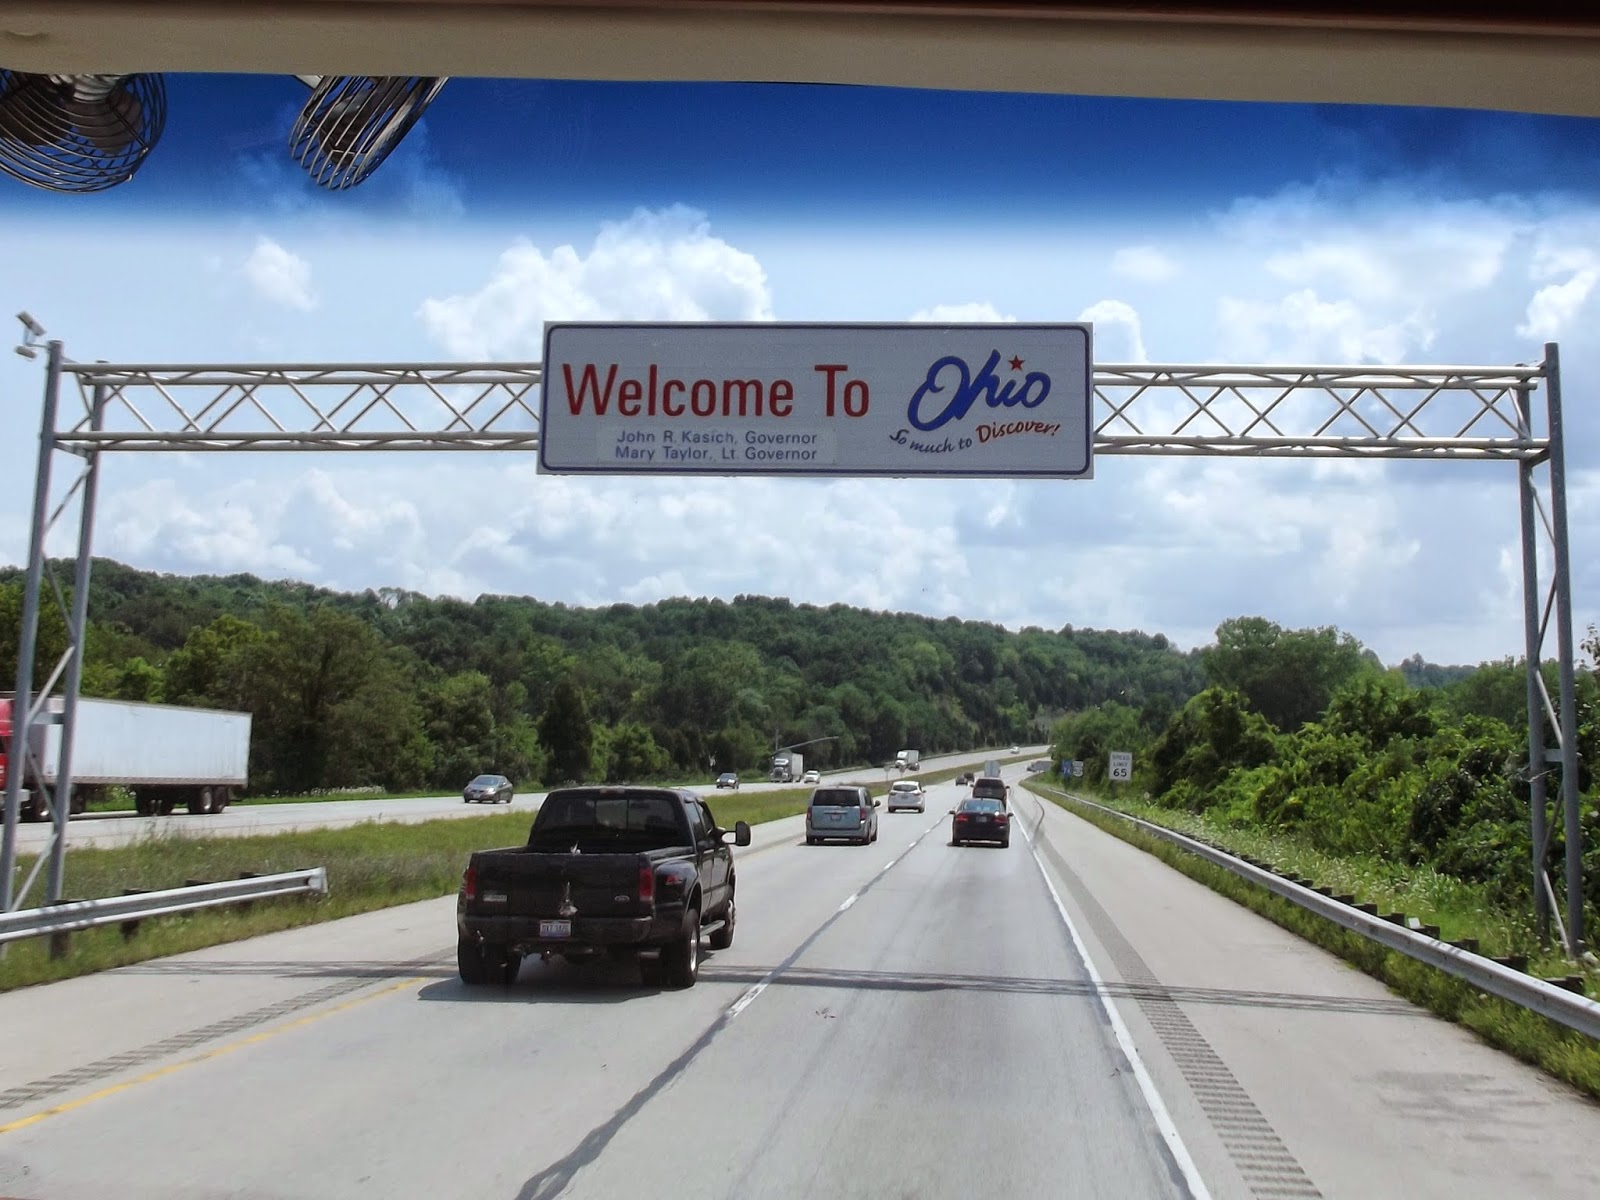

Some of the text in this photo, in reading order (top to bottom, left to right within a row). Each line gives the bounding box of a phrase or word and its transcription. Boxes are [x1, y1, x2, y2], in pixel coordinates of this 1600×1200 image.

[562, 363, 869, 417] Welcome To
[907, 349, 1051, 431] Ohio
[617, 430, 655, 443] John
[745, 430, 818, 444] Governor
[889, 420, 1061, 453] So much to Discover!
[615, 446, 655, 461] Mary
[745, 446, 817, 460] Governor
[1113, 768, 1127, 777] 65
